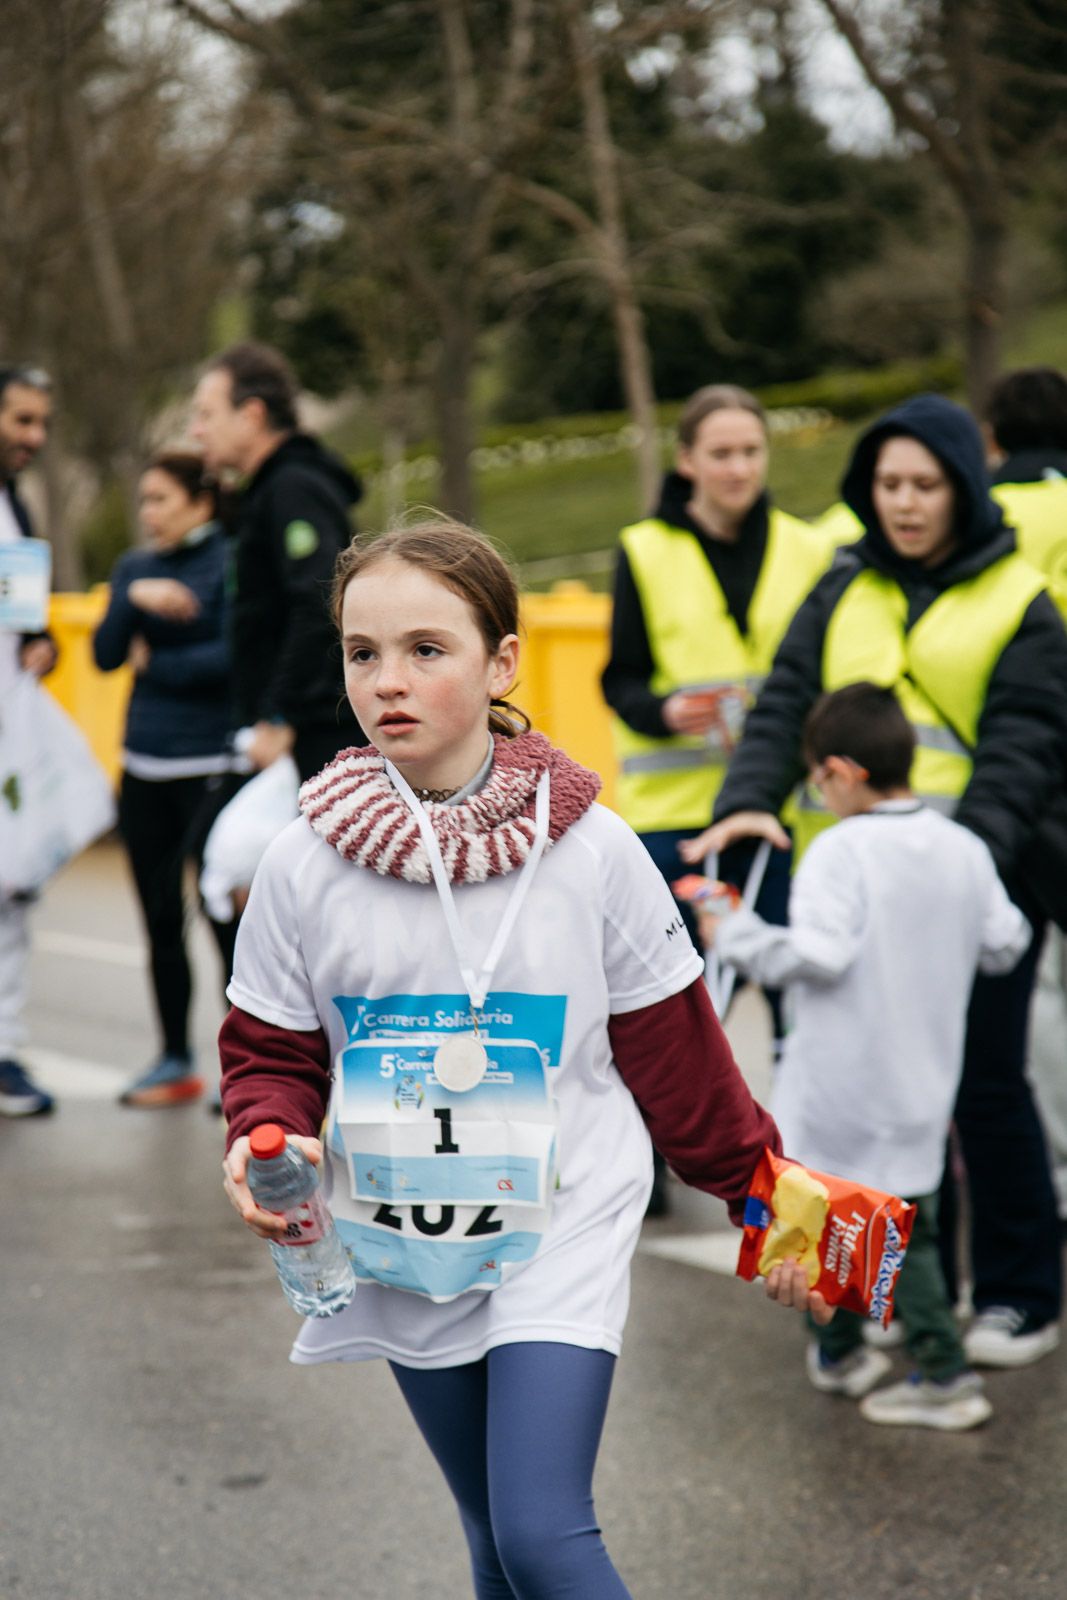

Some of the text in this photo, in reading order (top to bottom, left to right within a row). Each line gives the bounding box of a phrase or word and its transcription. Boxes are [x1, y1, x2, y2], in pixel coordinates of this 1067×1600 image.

[363, 1012, 429, 1027] Carrera
[433, 1008, 513, 1028] Solidaria
[434, 1108, 459, 1153] 1
